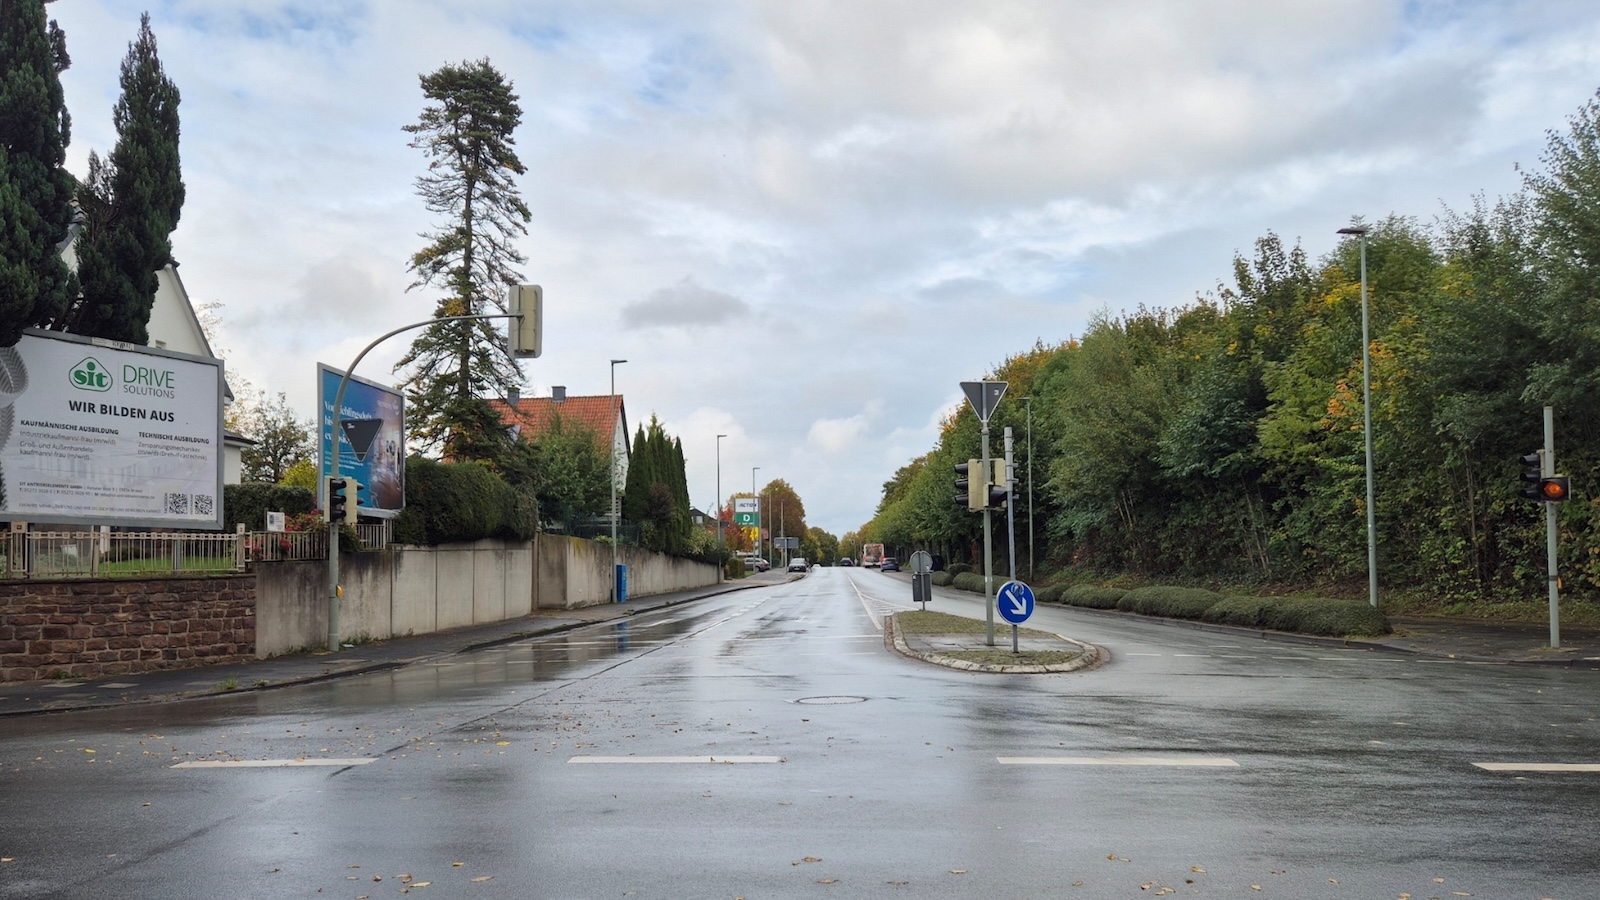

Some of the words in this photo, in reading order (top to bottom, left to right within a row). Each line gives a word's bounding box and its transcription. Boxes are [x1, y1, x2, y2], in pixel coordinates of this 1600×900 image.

[73, 361, 109, 388] sit
[123, 364, 175, 389] DRIVE
[123, 384, 175, 399] SOLUTIONS
[69, 400, 96, 413] WIR
[100, 403, 146, 419] BILDEN
[150, 410, 175, 422] AUS
[20, 419, 78, 431] KAUFMÄNNISCHE
[78, 425, 119, 435] AUSBILDUNG
[138, 431, 173, 441] TECHNISCHE
[174, 435, 210, 444] AUSBILDUNG
